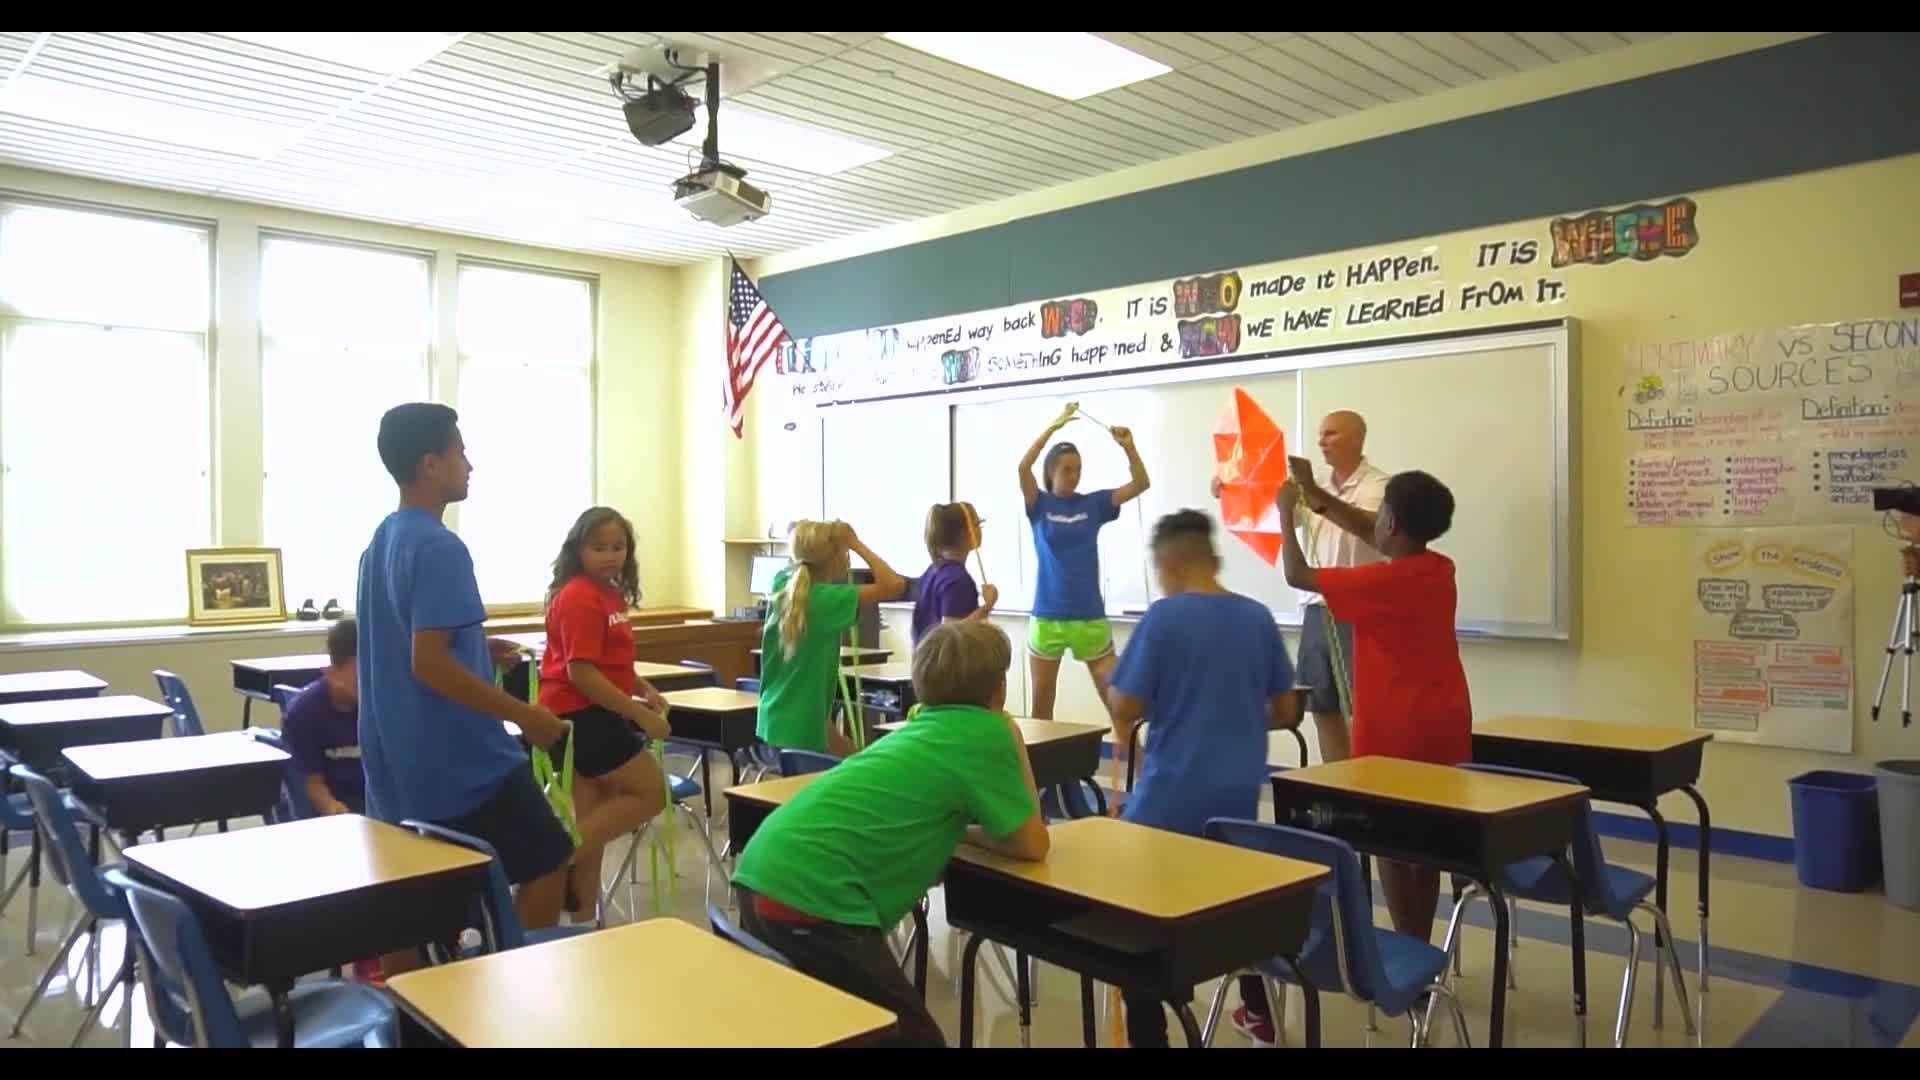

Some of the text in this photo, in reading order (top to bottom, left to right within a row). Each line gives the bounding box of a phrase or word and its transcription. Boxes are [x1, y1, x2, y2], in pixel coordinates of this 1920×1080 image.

[1476, 241, 1506, 269] IT
[1127, 299, 1142, 319] IT
[968, 324, 993, 341] way
[1003, 312, 1036, 332] back
[1160, 332, 1174, 353] &
[1707, 354, 1873, 395] SOURCES
[1802, 394, 1890, 420] Definition:
